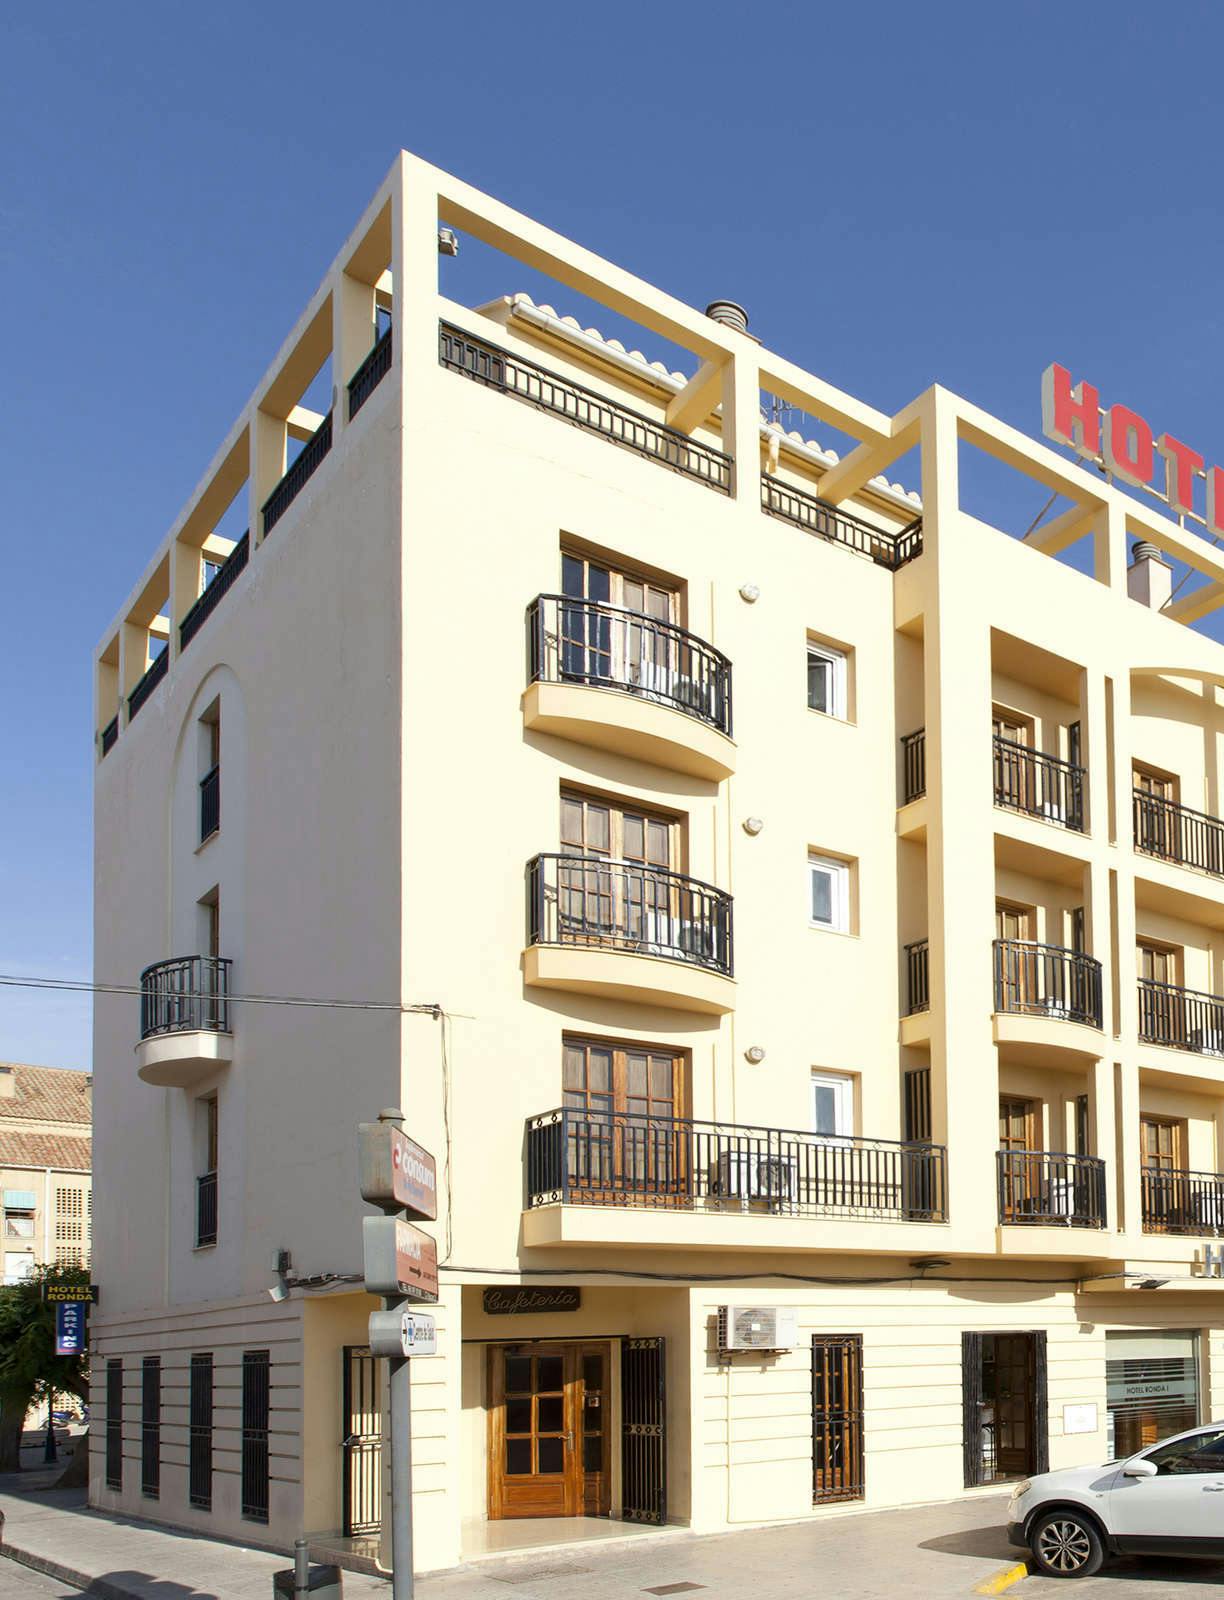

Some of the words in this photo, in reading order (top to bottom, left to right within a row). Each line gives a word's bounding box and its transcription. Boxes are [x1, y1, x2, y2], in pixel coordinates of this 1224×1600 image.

[47, 1293, 94, 1301] RONDA
[63, 1303, 78, 1348] PARKING
[1126, 1386, 1145, 1395] HOTEL
[1145, 1385, 1166, 1393] RONDA
